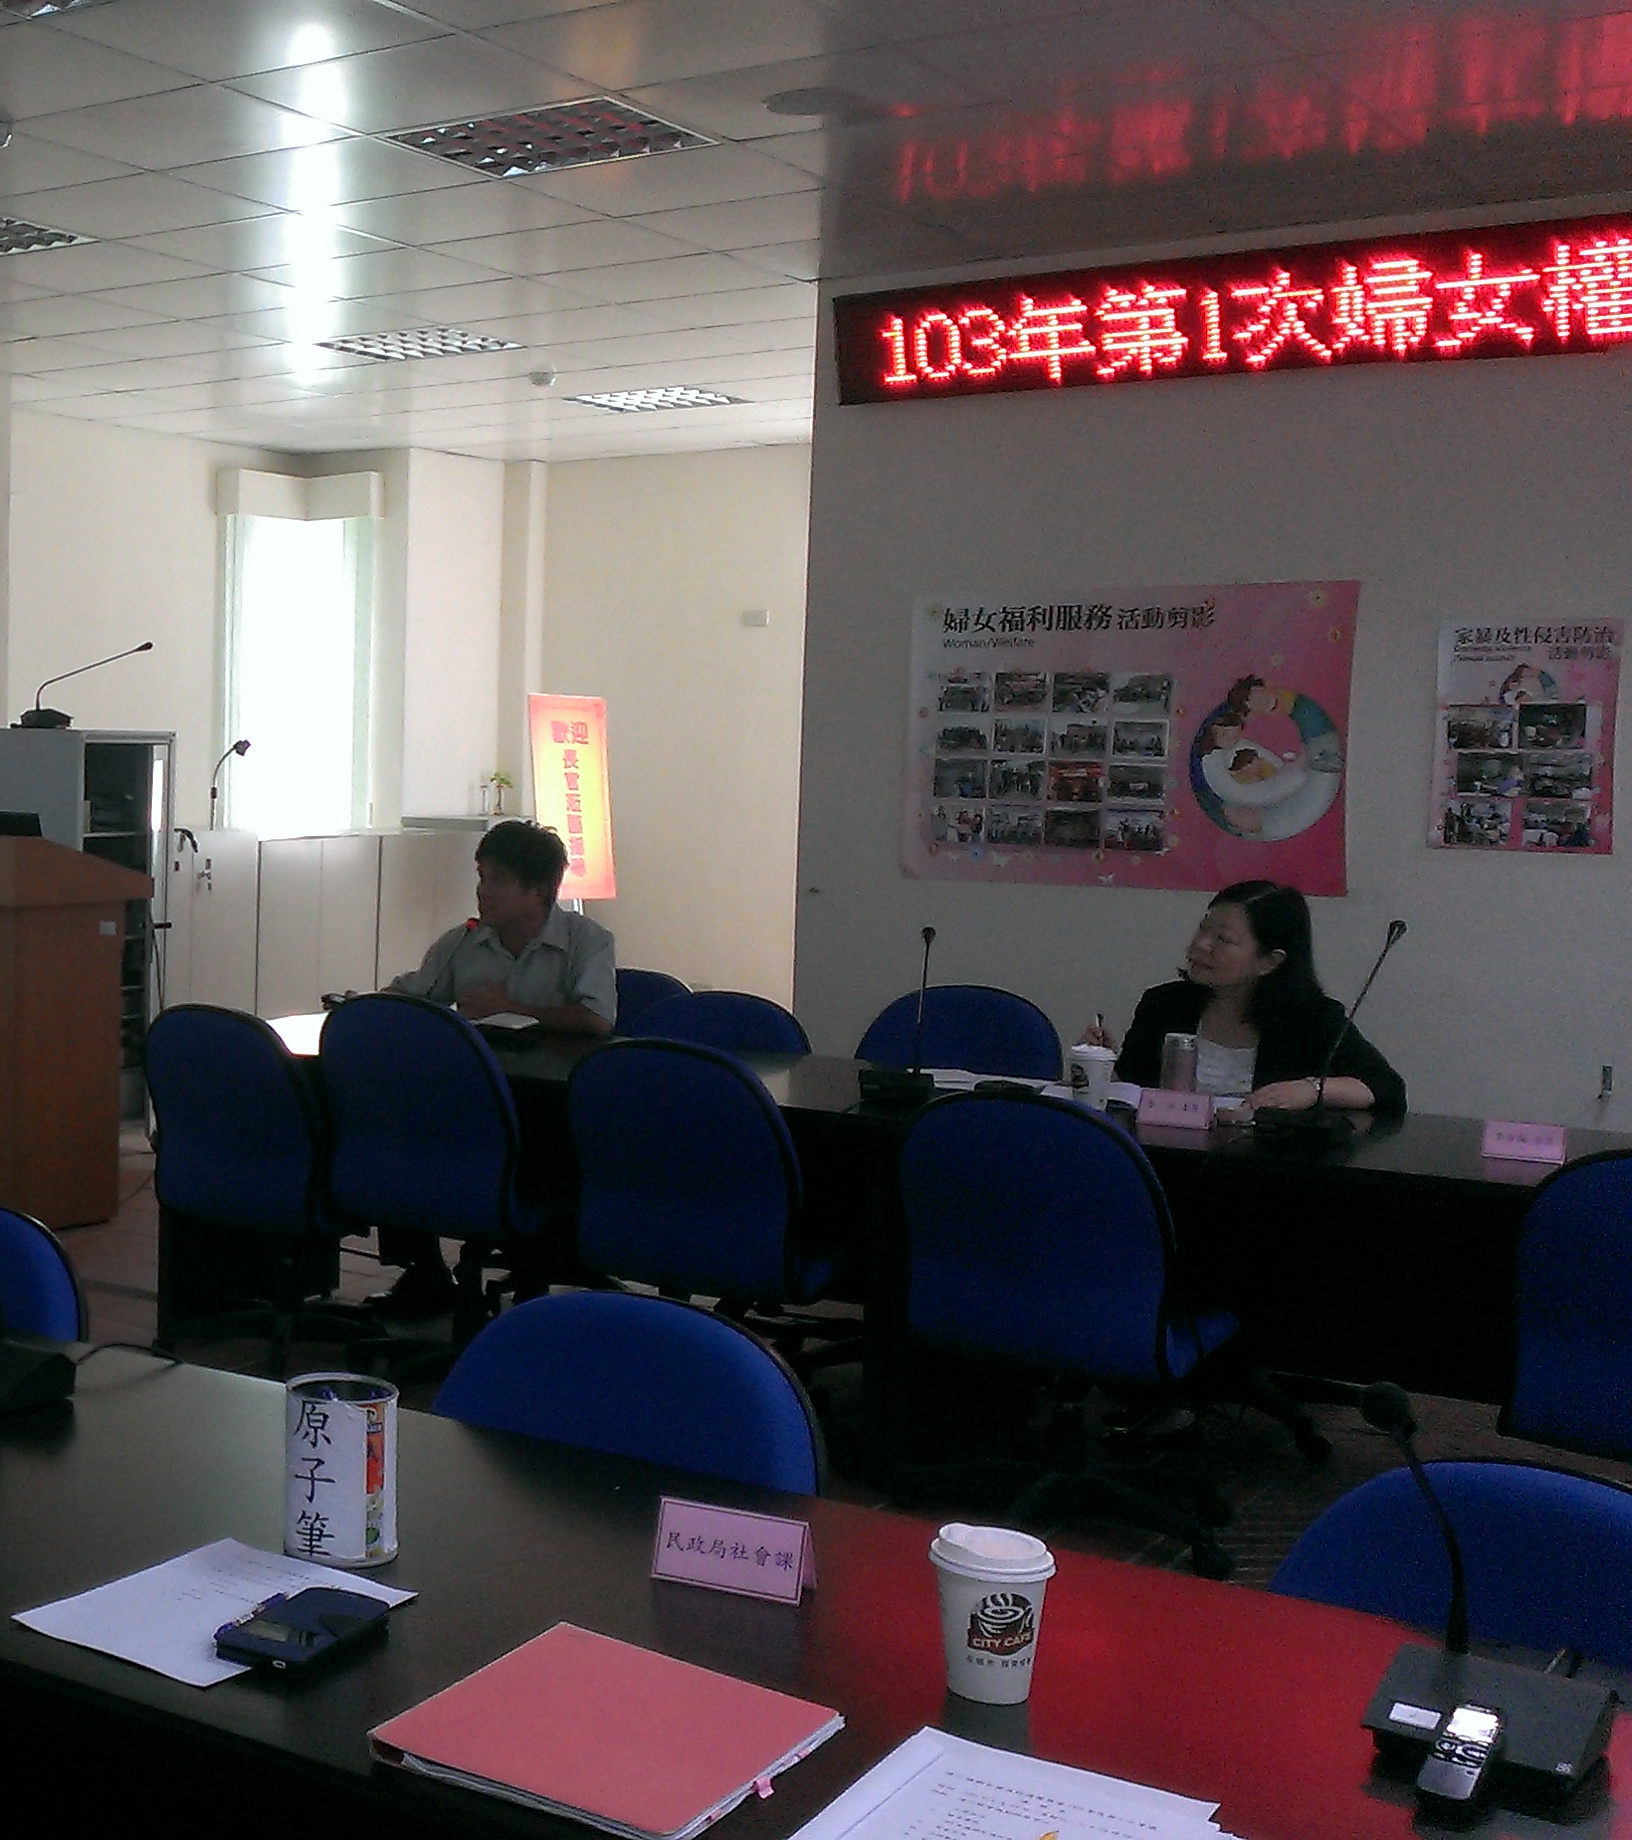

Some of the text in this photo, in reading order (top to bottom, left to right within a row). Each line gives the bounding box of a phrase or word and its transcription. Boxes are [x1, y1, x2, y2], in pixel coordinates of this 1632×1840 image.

[293, 1399, 336, 1557] 原子筆
[666, 1531, 795, 1572] 民政局社會課
[972, 1637, 1002, 1649] CITY
